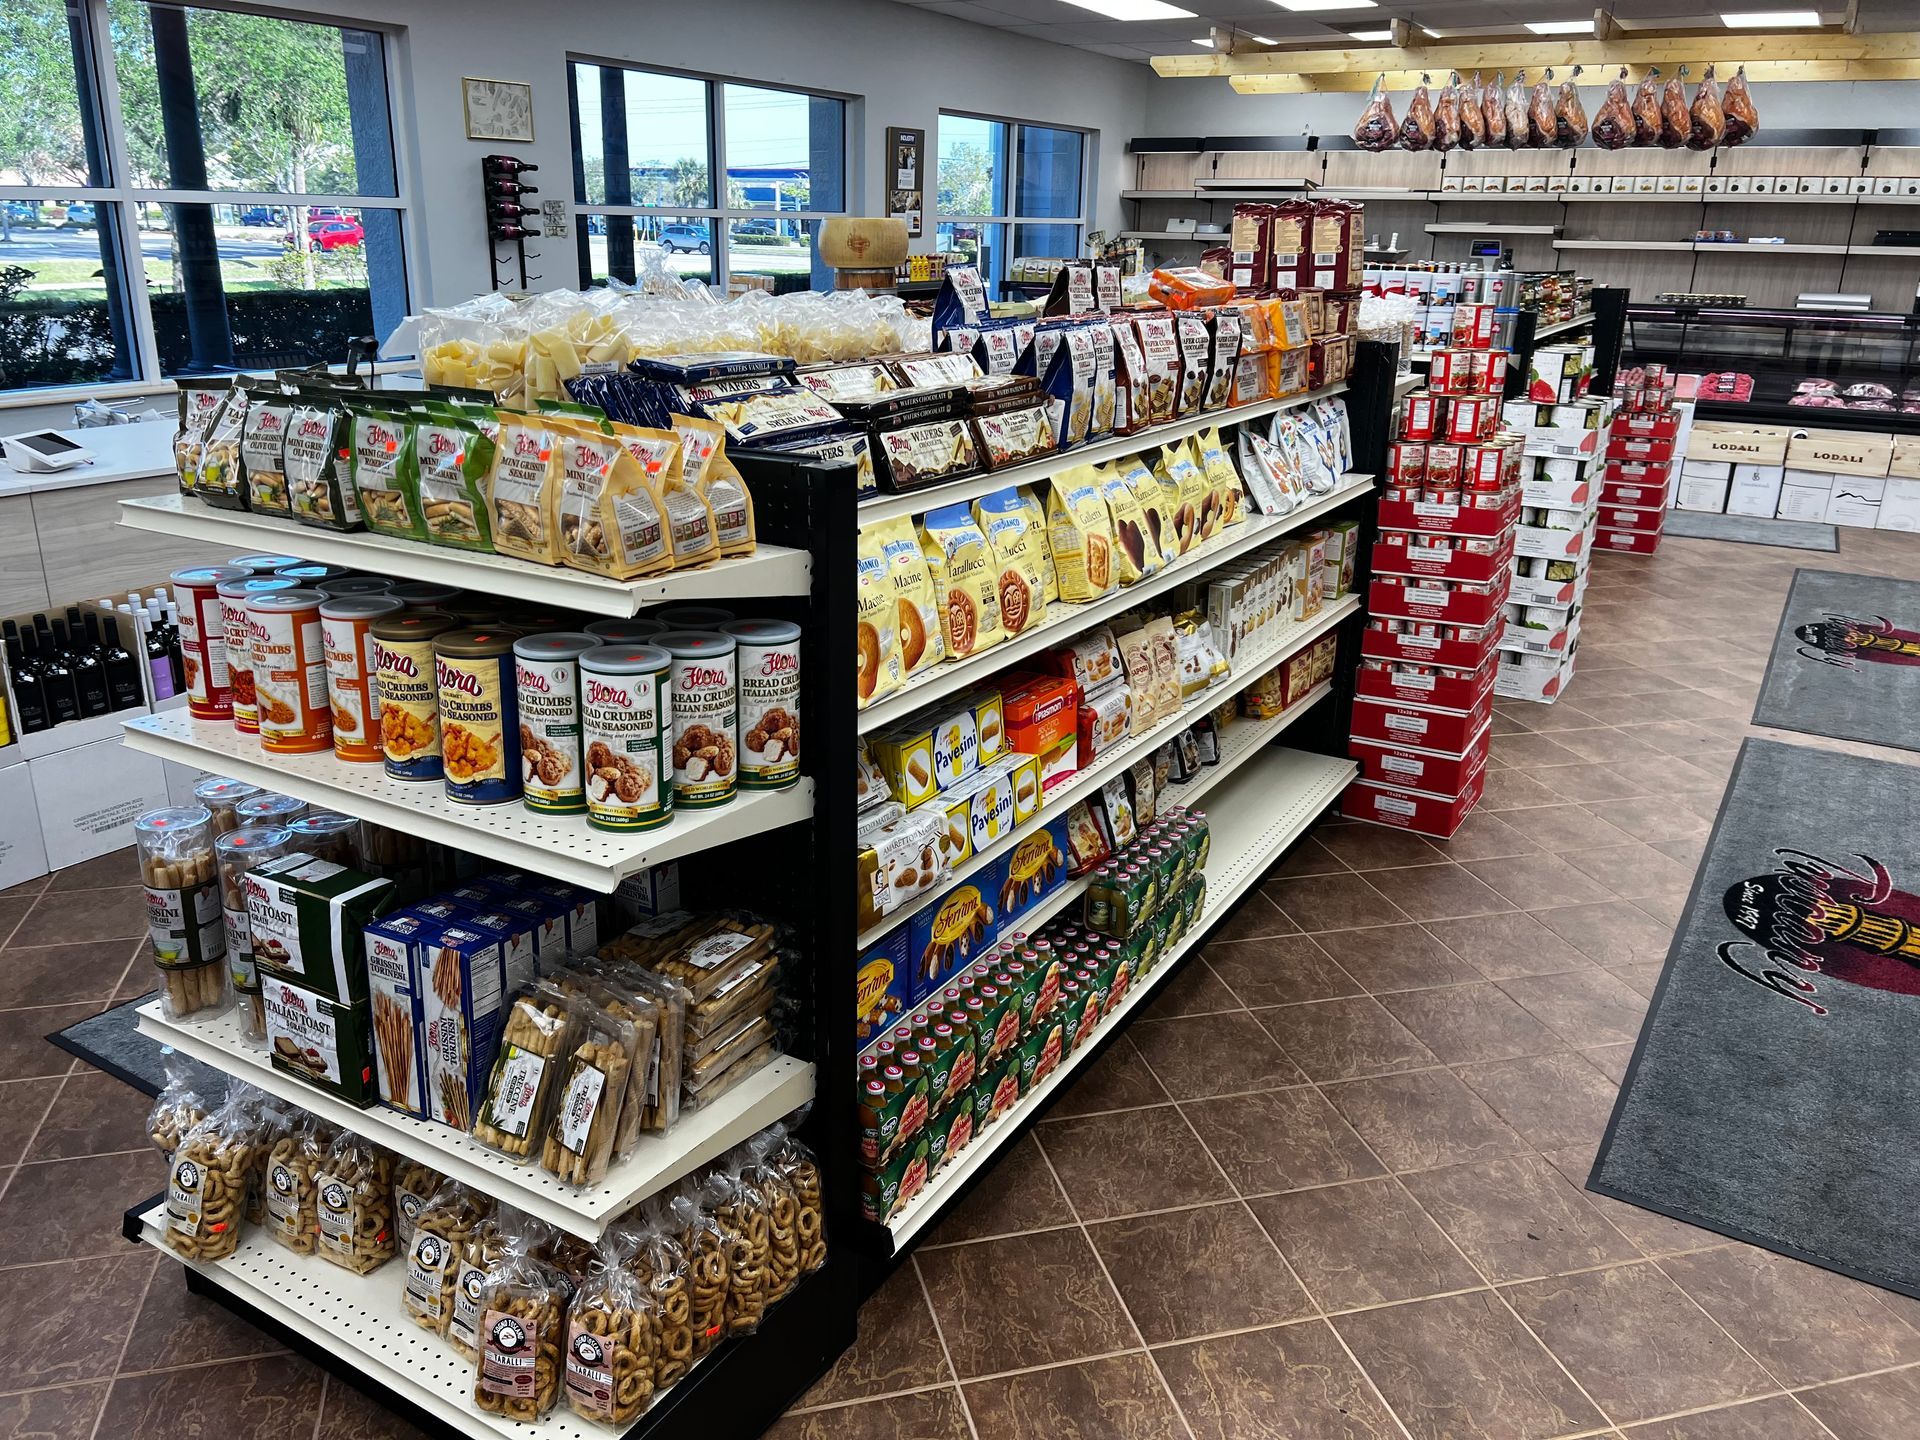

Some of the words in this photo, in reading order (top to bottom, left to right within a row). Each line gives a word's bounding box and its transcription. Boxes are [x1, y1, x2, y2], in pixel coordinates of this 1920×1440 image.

[716, 379, 761, 393] WAFERS
[900, 396, 921, 406] WAFERS
[921, 392, 946, 403] CHOCOLATE
[258, 411, 281, 431] Flora
[903, 411, 921, 421] WAFERS
[921, 406, 946, 417] CHOCOLATE
[298, 418, 327, 438] Flora
[767, 415, 808, 429] WAFERS
[367, 424, 394, 445] Flora
[890, 435, 912, 453] Flora
[910, 430, 944, 442] WAFERS
[250, 440, 266, 450] OLIVE
[266, 442, 278, 451] OIL
[287, 437, 304, 449] MINI
[429, 433, 456, 455] Flora
[514, 434, 541, 458] Flora
[1713, 442, 1760, 453] LODALI
[292, 448, 315, 459] OLIVE
[357, 446, 374, 457] MINI
[575, 445, 604, 469] Flora
[1814, 452, 1864, 463] LODALI
[501, 457, 519, 466] MINI
[520, 459, 545, 470] GRISSINI
[509, 467, 537, 481] SESAME
[566, 470, 586, 481] MINI
[858, 559, 879, 573] BIANCO
[947, 554, 986, 578] Tarallucci
[894, 570, 922, 590] Macine
[857, 593, 885, 613] Macine
[225, 636, 244, 647] PLAIN
[252, 643, 291, 655] CRUMBS
[761, 652, 798, 676] Flora
[1158, 653, 1170, 664] SAPORI
[681, 666, 727, 690] Flora
[1131, 664, 1149, 676] SAPORI
[388, 683, 428, 692] CRUMBS
[743, 678, 780, 688] BREAD
[384, 692, 434, 701] SEASONED
[586, 679, 633, 707] Flora
[743, 687, 778, 697] ITALIAN
[450, 700, 493, 712] CRUMBS
[526, 696, 572, 707] CRUMBS
[447, 710, 498, 722] SEASONED
[525, 707, 573, 716] SEASONED
[603, 709, 653, 722] CRUMBS
[1037, 702, 1063, 721] Plasmon
[1397, 708, 1412, 716] 12x28
[601, 720, 654, 732] SEASONED
[935, 729, 977, 773] Pavesini
[971, 790, 1012, 835] Pavesini
[883, 836, 912, 855] AMARETTO
[918, 819, 938, 836] MATILDE
[1011, 839, 1051, 875] Ferrara
[244, 876, 269, 903] Flora
[1742, 881, 1764, 903] Since
[263, 904, 293, 925] TOAST
[934, 896, 979, 939] Ferrara
[1736, 905, 1760, 930] 1997
[374, 941, 398, 961] Flora
[370, 956, 404, 972] GRISSINI
[370, 964, 406, 981] TORINESI
[281, 985, 307, 1014] Flora
[299, 1013, 331, 1036] TOAST
[428, 1020, 440, 1052] Flora
[440, 1017, 450, 1062] GRISSINI
[449, 1018, 458, 1065] TORINESI
[507, 1069, 527, 1115] TRECCINE
[572, 1084, 590, 1132] TRECCINE
[325, 1212, 348, 1225] TARALLI
[413, 1270, 434, 1285] TARALLI
[494, 1319, 507, 1336] SOGNO
[493, 1354, 522, 1366] TARALLI
[574, 1365, 602, 1381] TARALLI
